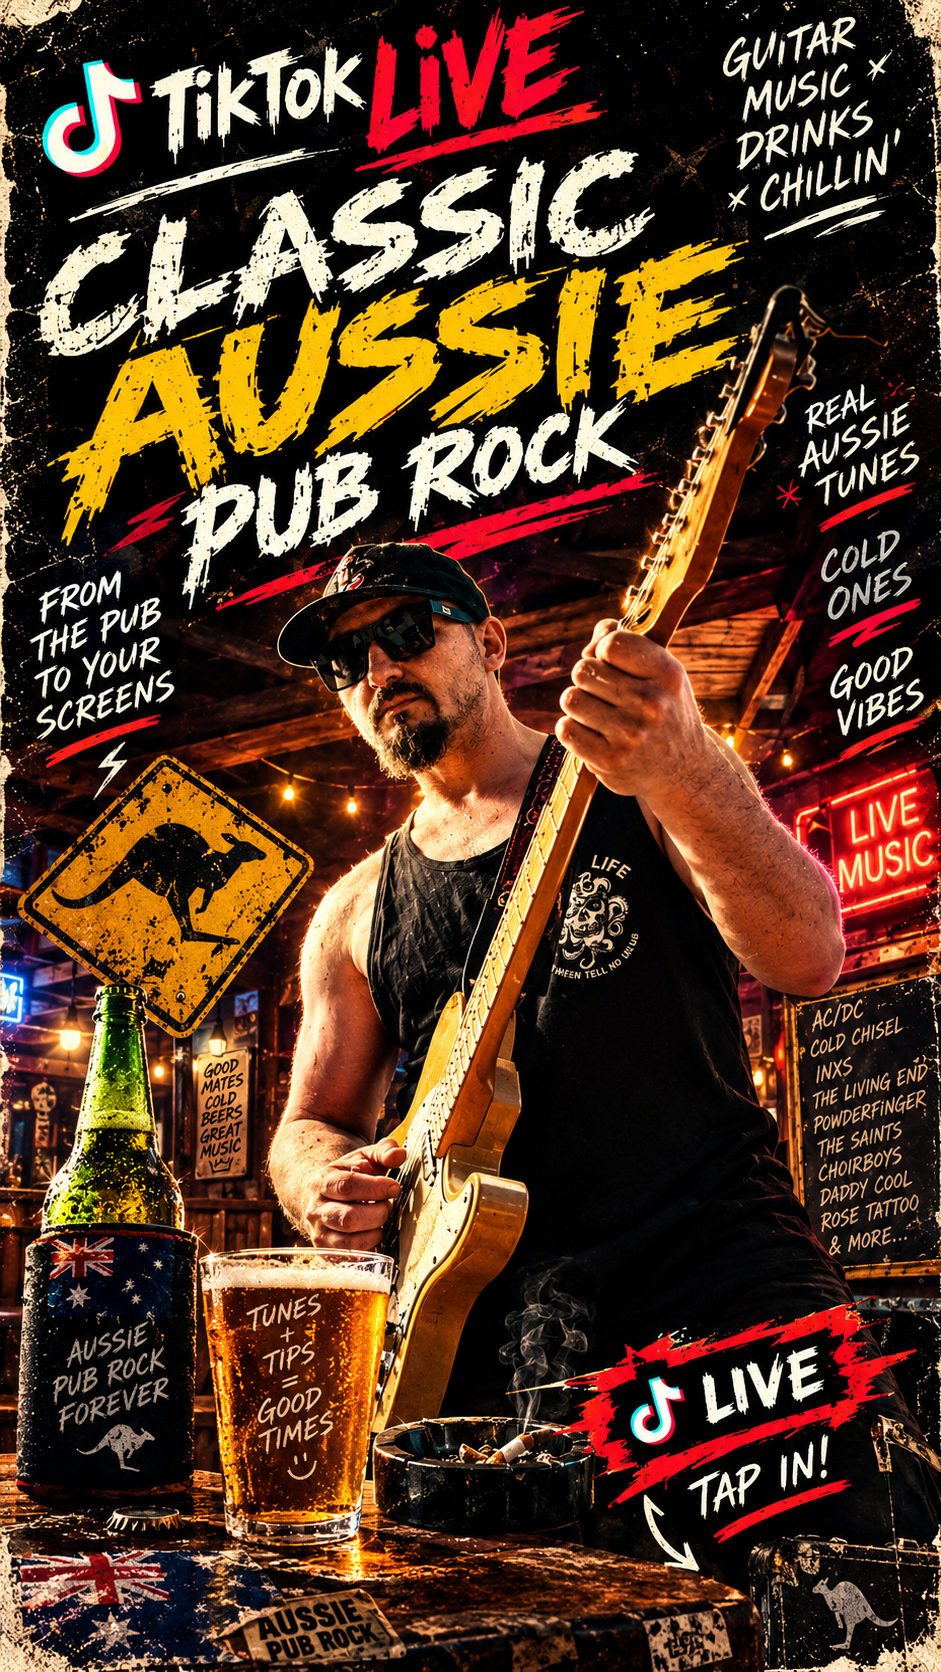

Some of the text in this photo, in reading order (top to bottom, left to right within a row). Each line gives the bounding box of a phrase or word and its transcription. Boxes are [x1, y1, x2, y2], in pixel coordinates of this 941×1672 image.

[150, 42, 367, 165] TikTok
[742, 62, 851, 123] MUSIC
[736, 100, 874, 170] DRINKS
[760, 128, 901, 211] CHILLIN'
[38, 149, 654, 357] CLASSIC
[48, 239, 748, 545] AUSSIE
[804, 384, 876, 434] REAL
[798, 401, 911, 478] AUSSIE
[814, 440, 920, 506] TUNES
[180, 399, 640, 610] PUB ROCK
[821, 530, 900, 583] COLD
[38, 570, 121, 624] FROM
[827, 562, 912, 620] ONES
[29, 597, 162, 663] THE PUB
[34, 637, 161, 699] TO YOUR
[830, 647, 914, 700] GOOD
[36, 670, 175, 740] SCREENS
[837, 678, 924, 736] VIBES
[850, 787, 919, 844] LIVE
[591, 854, 632, 880] LIFE
[838, 831, 933, 892] MUSIC
[584, 967, 608, 979] TELL
[608, 958, 622, 971] NO
[810, 1016, 904, 1057] COLD CHISEL
[811, 999, 864, 1033] AC/DC
[201, 1072, 244, 1095] MATES
[204, 1059, 239, 1079] GOOD
[812, 1063, 928, 1109] THE LIVING END
[815, 1056, 853, 1084] INXS
[200, 1104, 243, 1127] BEERS
[205, 1091, 237, 1110] COLD
[200, 1121, 243, 1144] GREAT
[200, 1137, 242, 1159] MUSIC
[817, 1121, 902, 1157] THE SAINTS
[818, 1146, 902, 1182] CHOIRBOYS
[820, 1170, 913, 1207] DADDY COOL
[820, 1193, 920, 1232] ROSE TATTOO
[828, 1226, 908, 1256] & MORE...
[246, 1293, 322, 1331] TUNES
[53, 1346, 166, 1405] PUB ROCK
[262, 1341, 315, 1375] TIPS
[58, 1377, 170, 1434] FOREVER
[257, 1387, 322, 1425] GOOD
[702, 1345, 825, 1424] LIVE
[258, 1410, 334, 1455] TIMES
[687, 1434, 829, 1519] TAP IN!
[258, 1600, 363, 1641] AUSSIE
[265, 1621, 380, 1663] PUB ROCK
